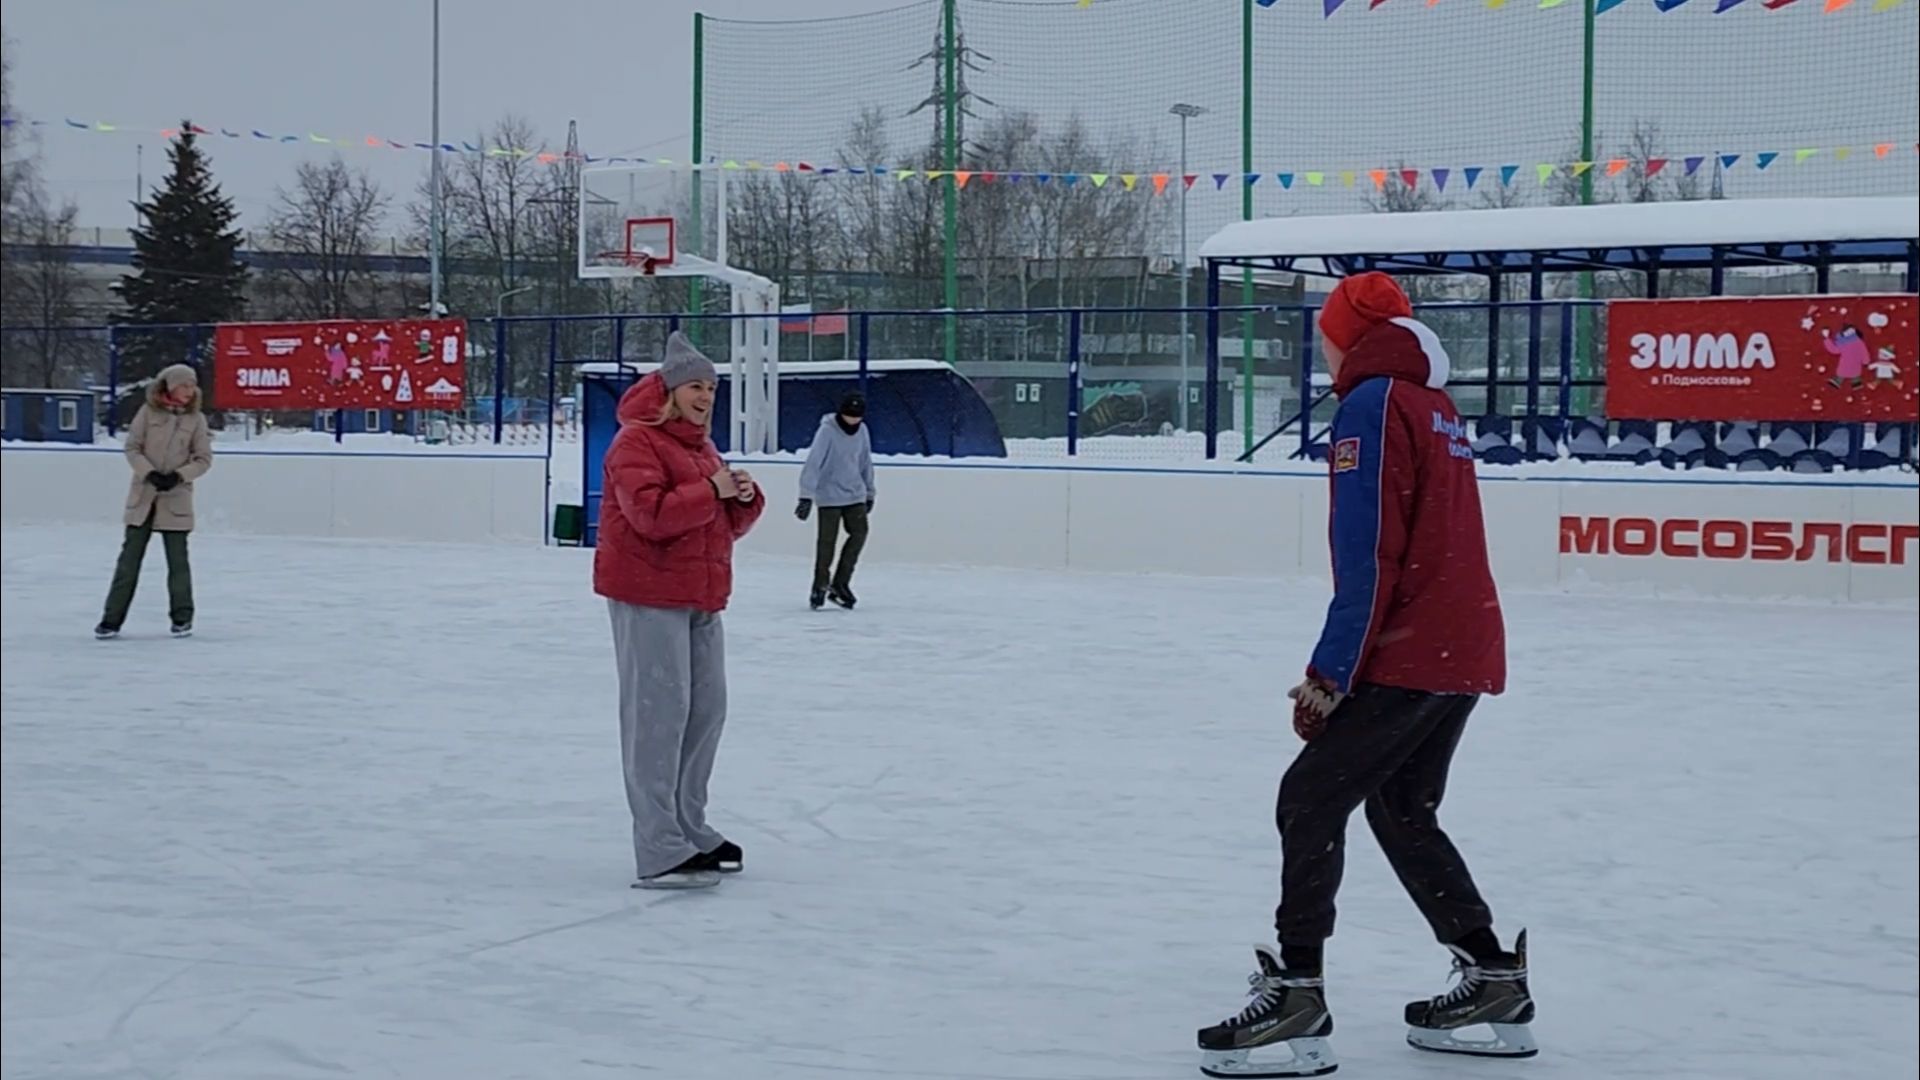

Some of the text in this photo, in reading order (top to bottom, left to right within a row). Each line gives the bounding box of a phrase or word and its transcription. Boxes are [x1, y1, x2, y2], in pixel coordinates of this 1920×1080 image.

[1630, 332, 1776, 369] ЗИМА
[236, 367, 291, 387] ЗИМА
[1651, 373, 1752, 386] в Подмосковье
